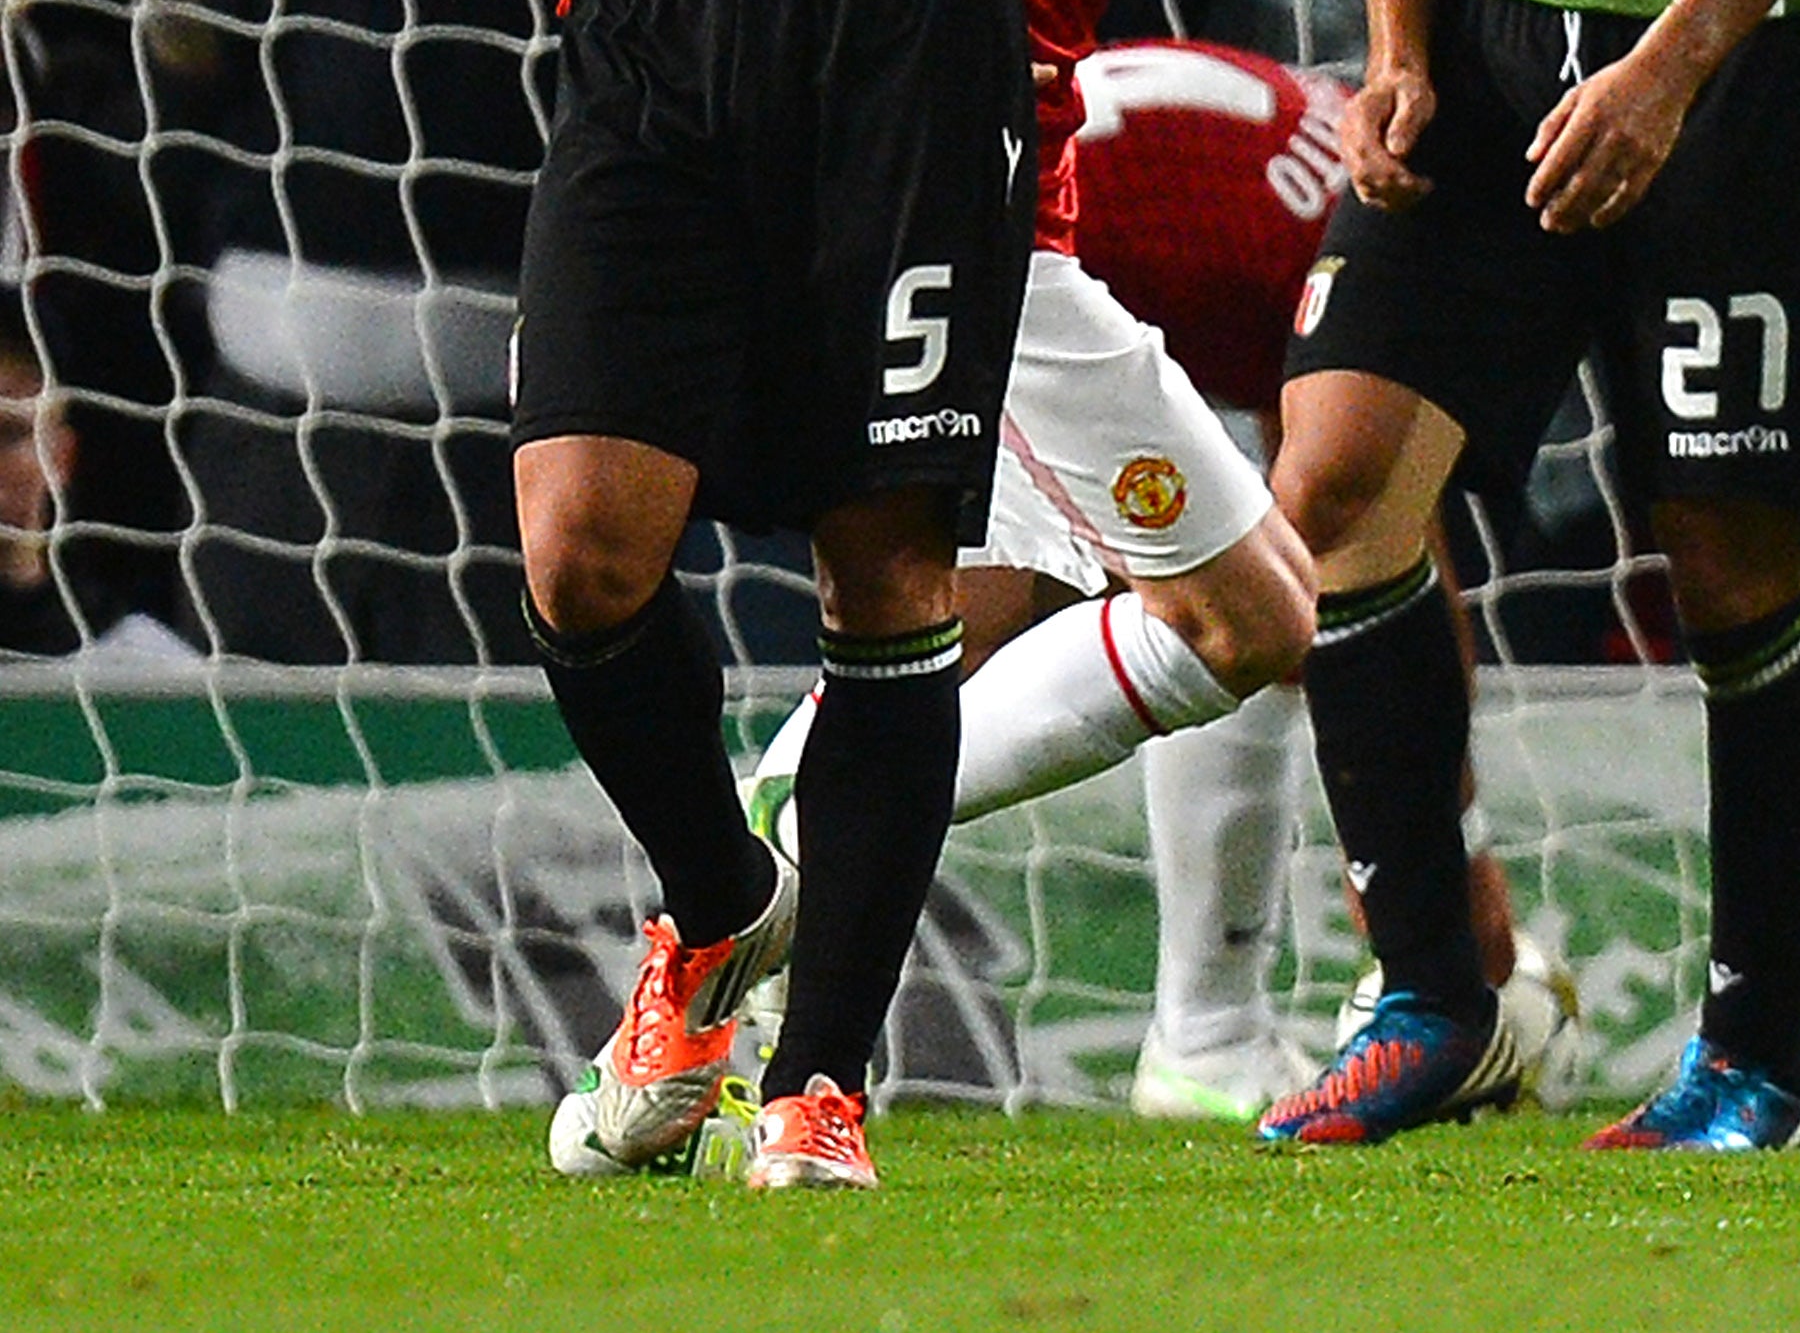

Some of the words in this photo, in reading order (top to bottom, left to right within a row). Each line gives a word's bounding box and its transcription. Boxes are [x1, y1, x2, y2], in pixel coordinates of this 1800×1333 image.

[884, 264, 952, 395] 5
[1661, 292, 1789, 419] 27
[868, 409, 981, 445] macron
[1668, 425, 1790, 457] macron
